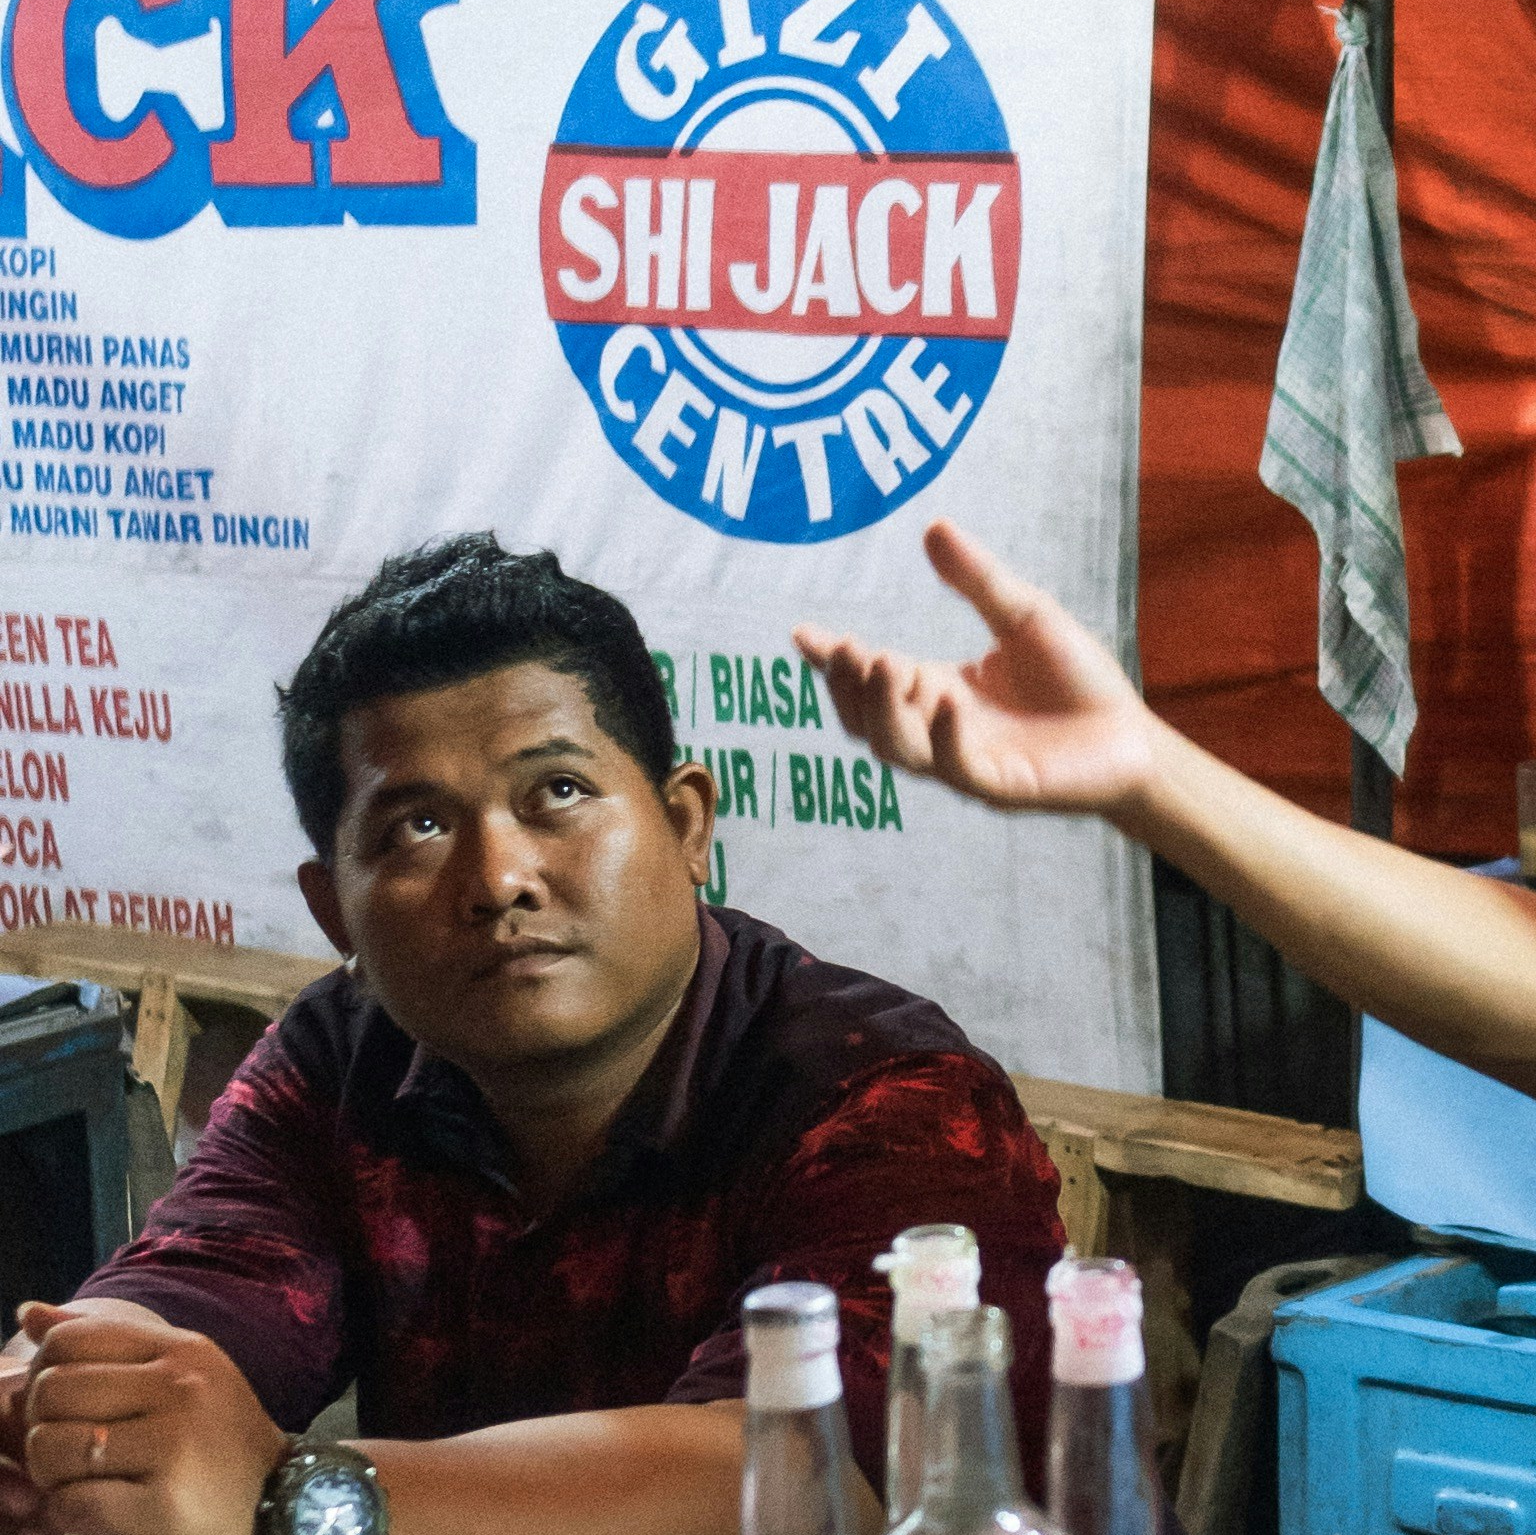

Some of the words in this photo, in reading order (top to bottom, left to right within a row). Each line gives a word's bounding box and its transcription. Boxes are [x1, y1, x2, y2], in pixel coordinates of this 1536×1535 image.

[558, 175, 715, 310] SHI
[730, 178, 1001, 318] JACK
[1, 332, 93, 365] MURNI
[103, 336, 190, 369] PANAS
[7, 376, 89, 409] MADU
[101, 380, 186, 413] ANGET
[12, 419, 94, 451] MADU
[103, 423, 165, 455] KOPI
[598, 325, 972, 523] CENTRE
[0, 461, 23, 491] U
[35, 460, 111, 496] MADU
[124, 465, 214, 501] ANGET
[11, 503, 97, 538] MURNI
[107, 508, 202, 544] TAWAR
[212, 512, 309, 550] DINGIN
[55, 615, 118, 668] TEA
[90, 686, 172, 743] KEJU
[709, 653, 822, 730] BIASA
[789, 752, 902, 832] BIASA
